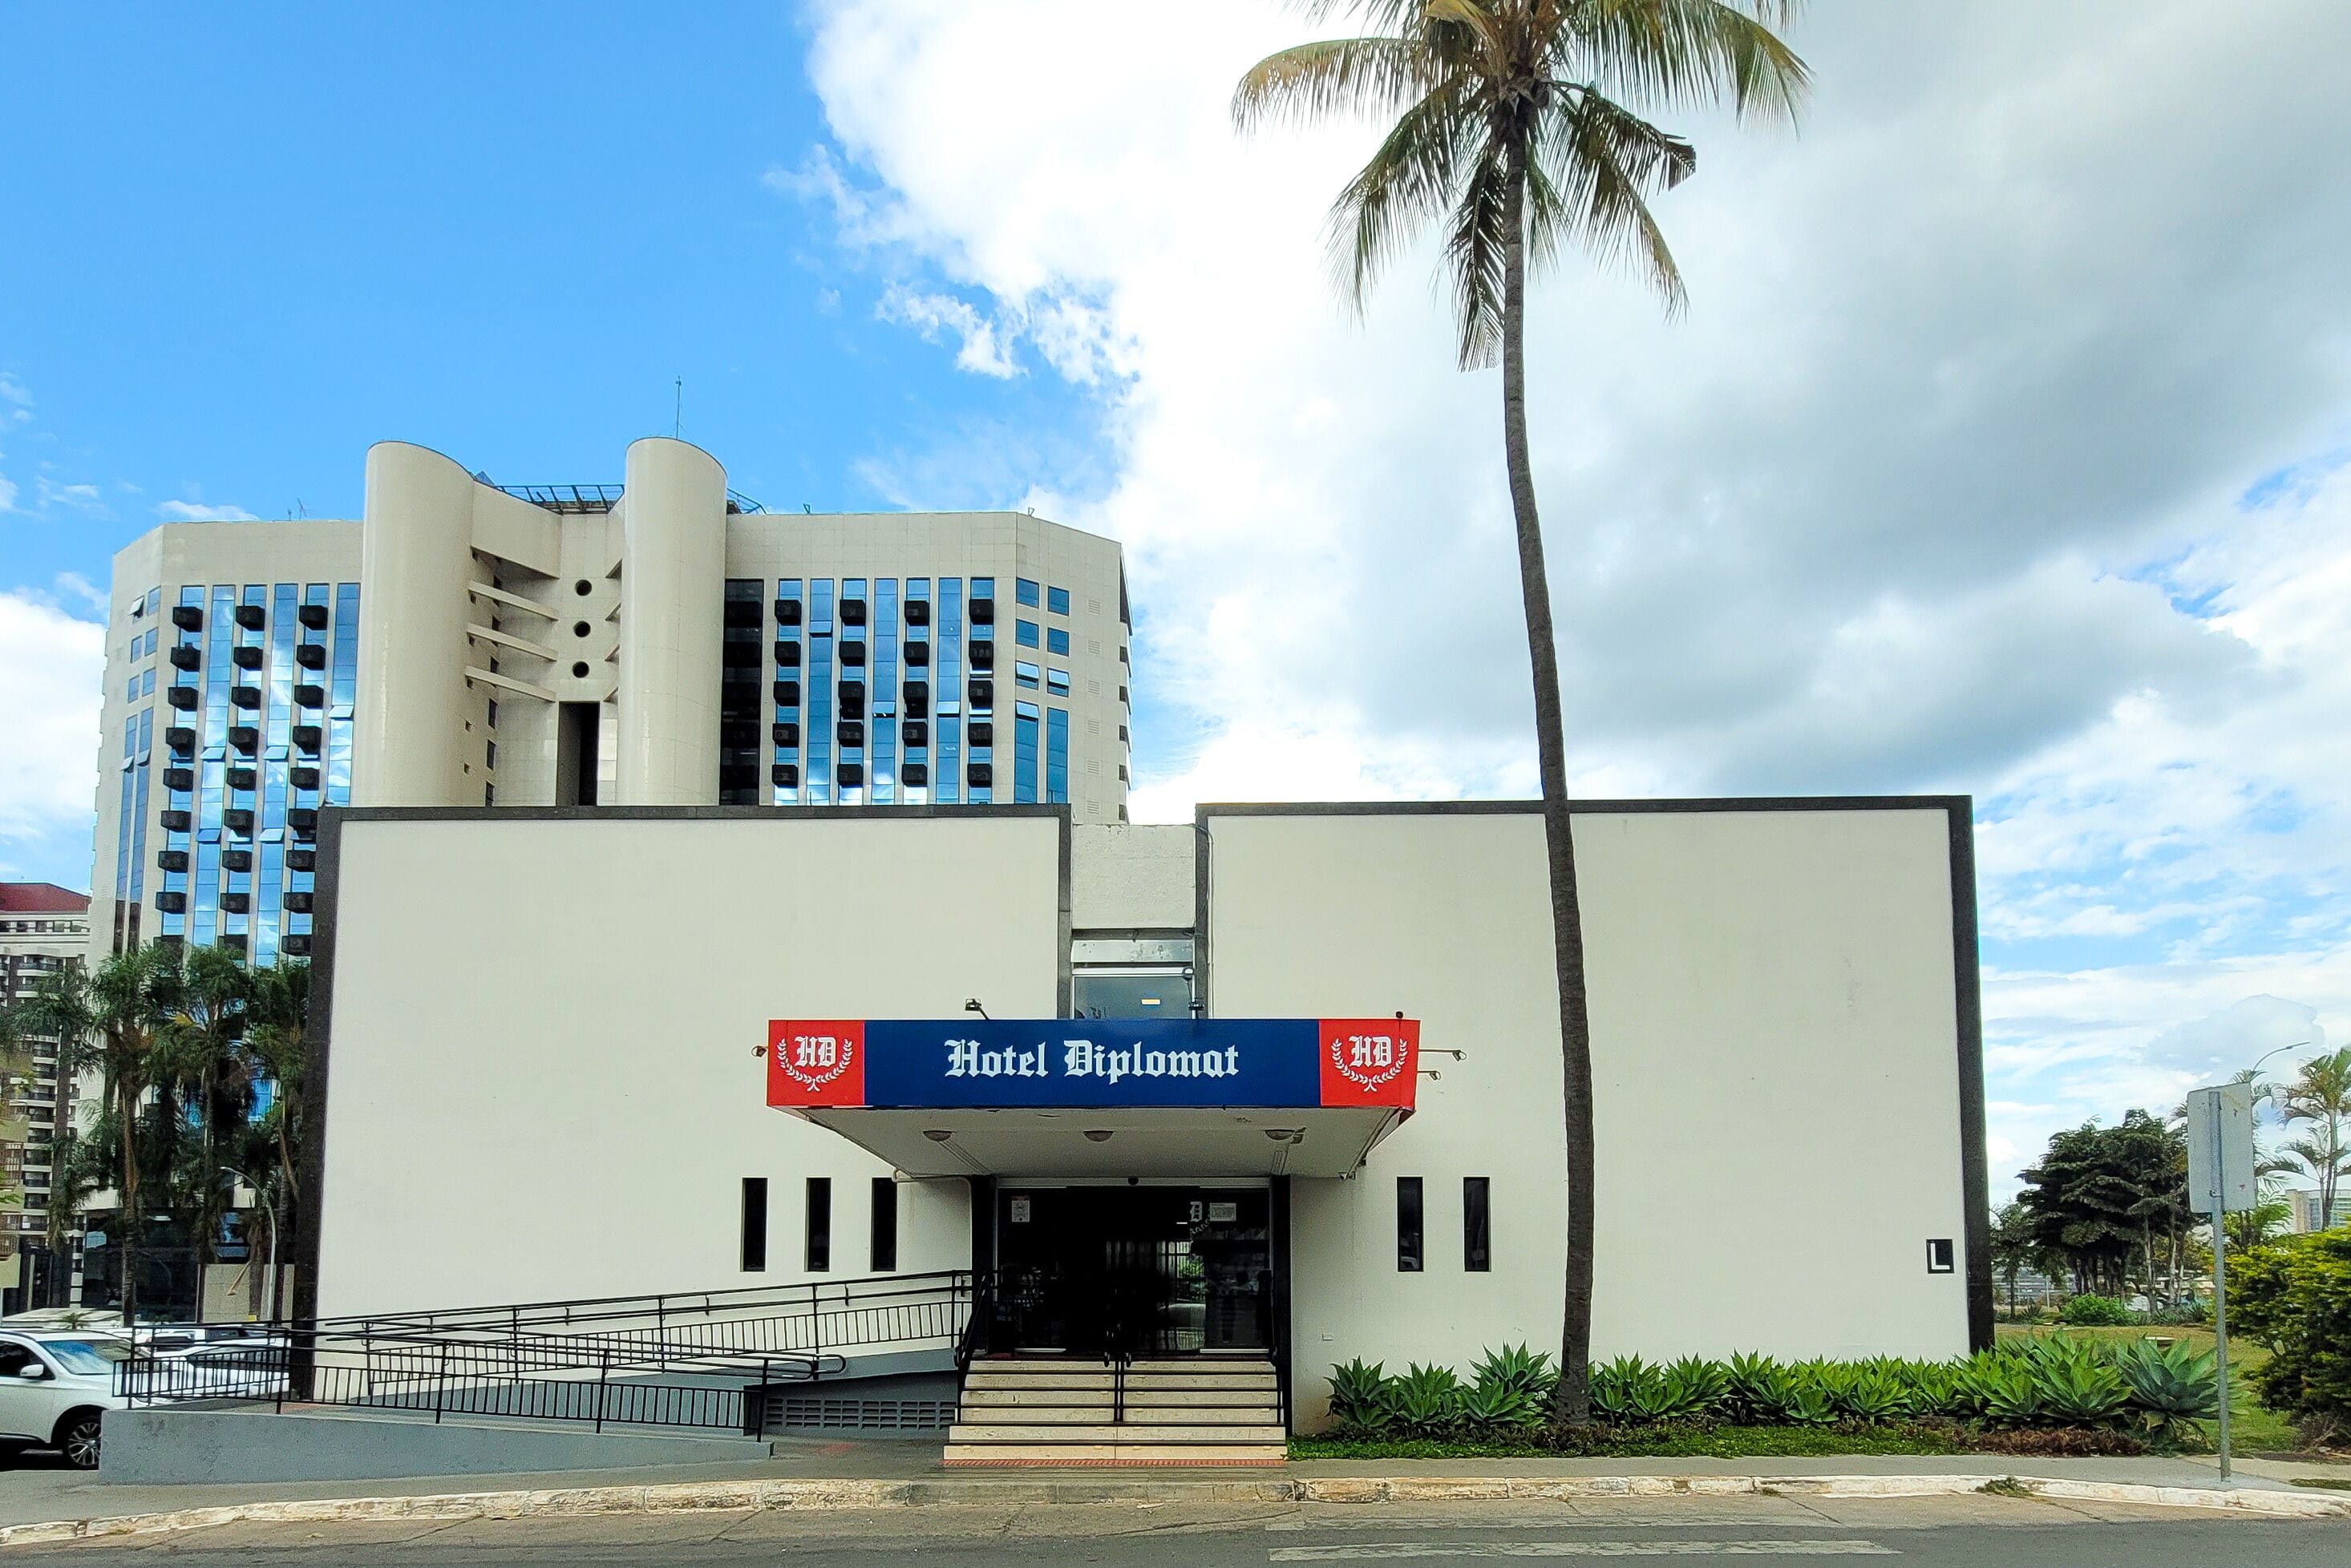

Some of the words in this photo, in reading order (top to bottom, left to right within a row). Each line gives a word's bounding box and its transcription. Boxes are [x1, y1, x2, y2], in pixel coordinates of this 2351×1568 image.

[794, 1036, 836, 1068] HD
[944, 1039, 1049, 1077] Hotel
[1063, 1040, 1239, 1085] Diplomat
[1349, 1035, 1393, 1068] HD
[1930, 1243, 1951, 1271] L
